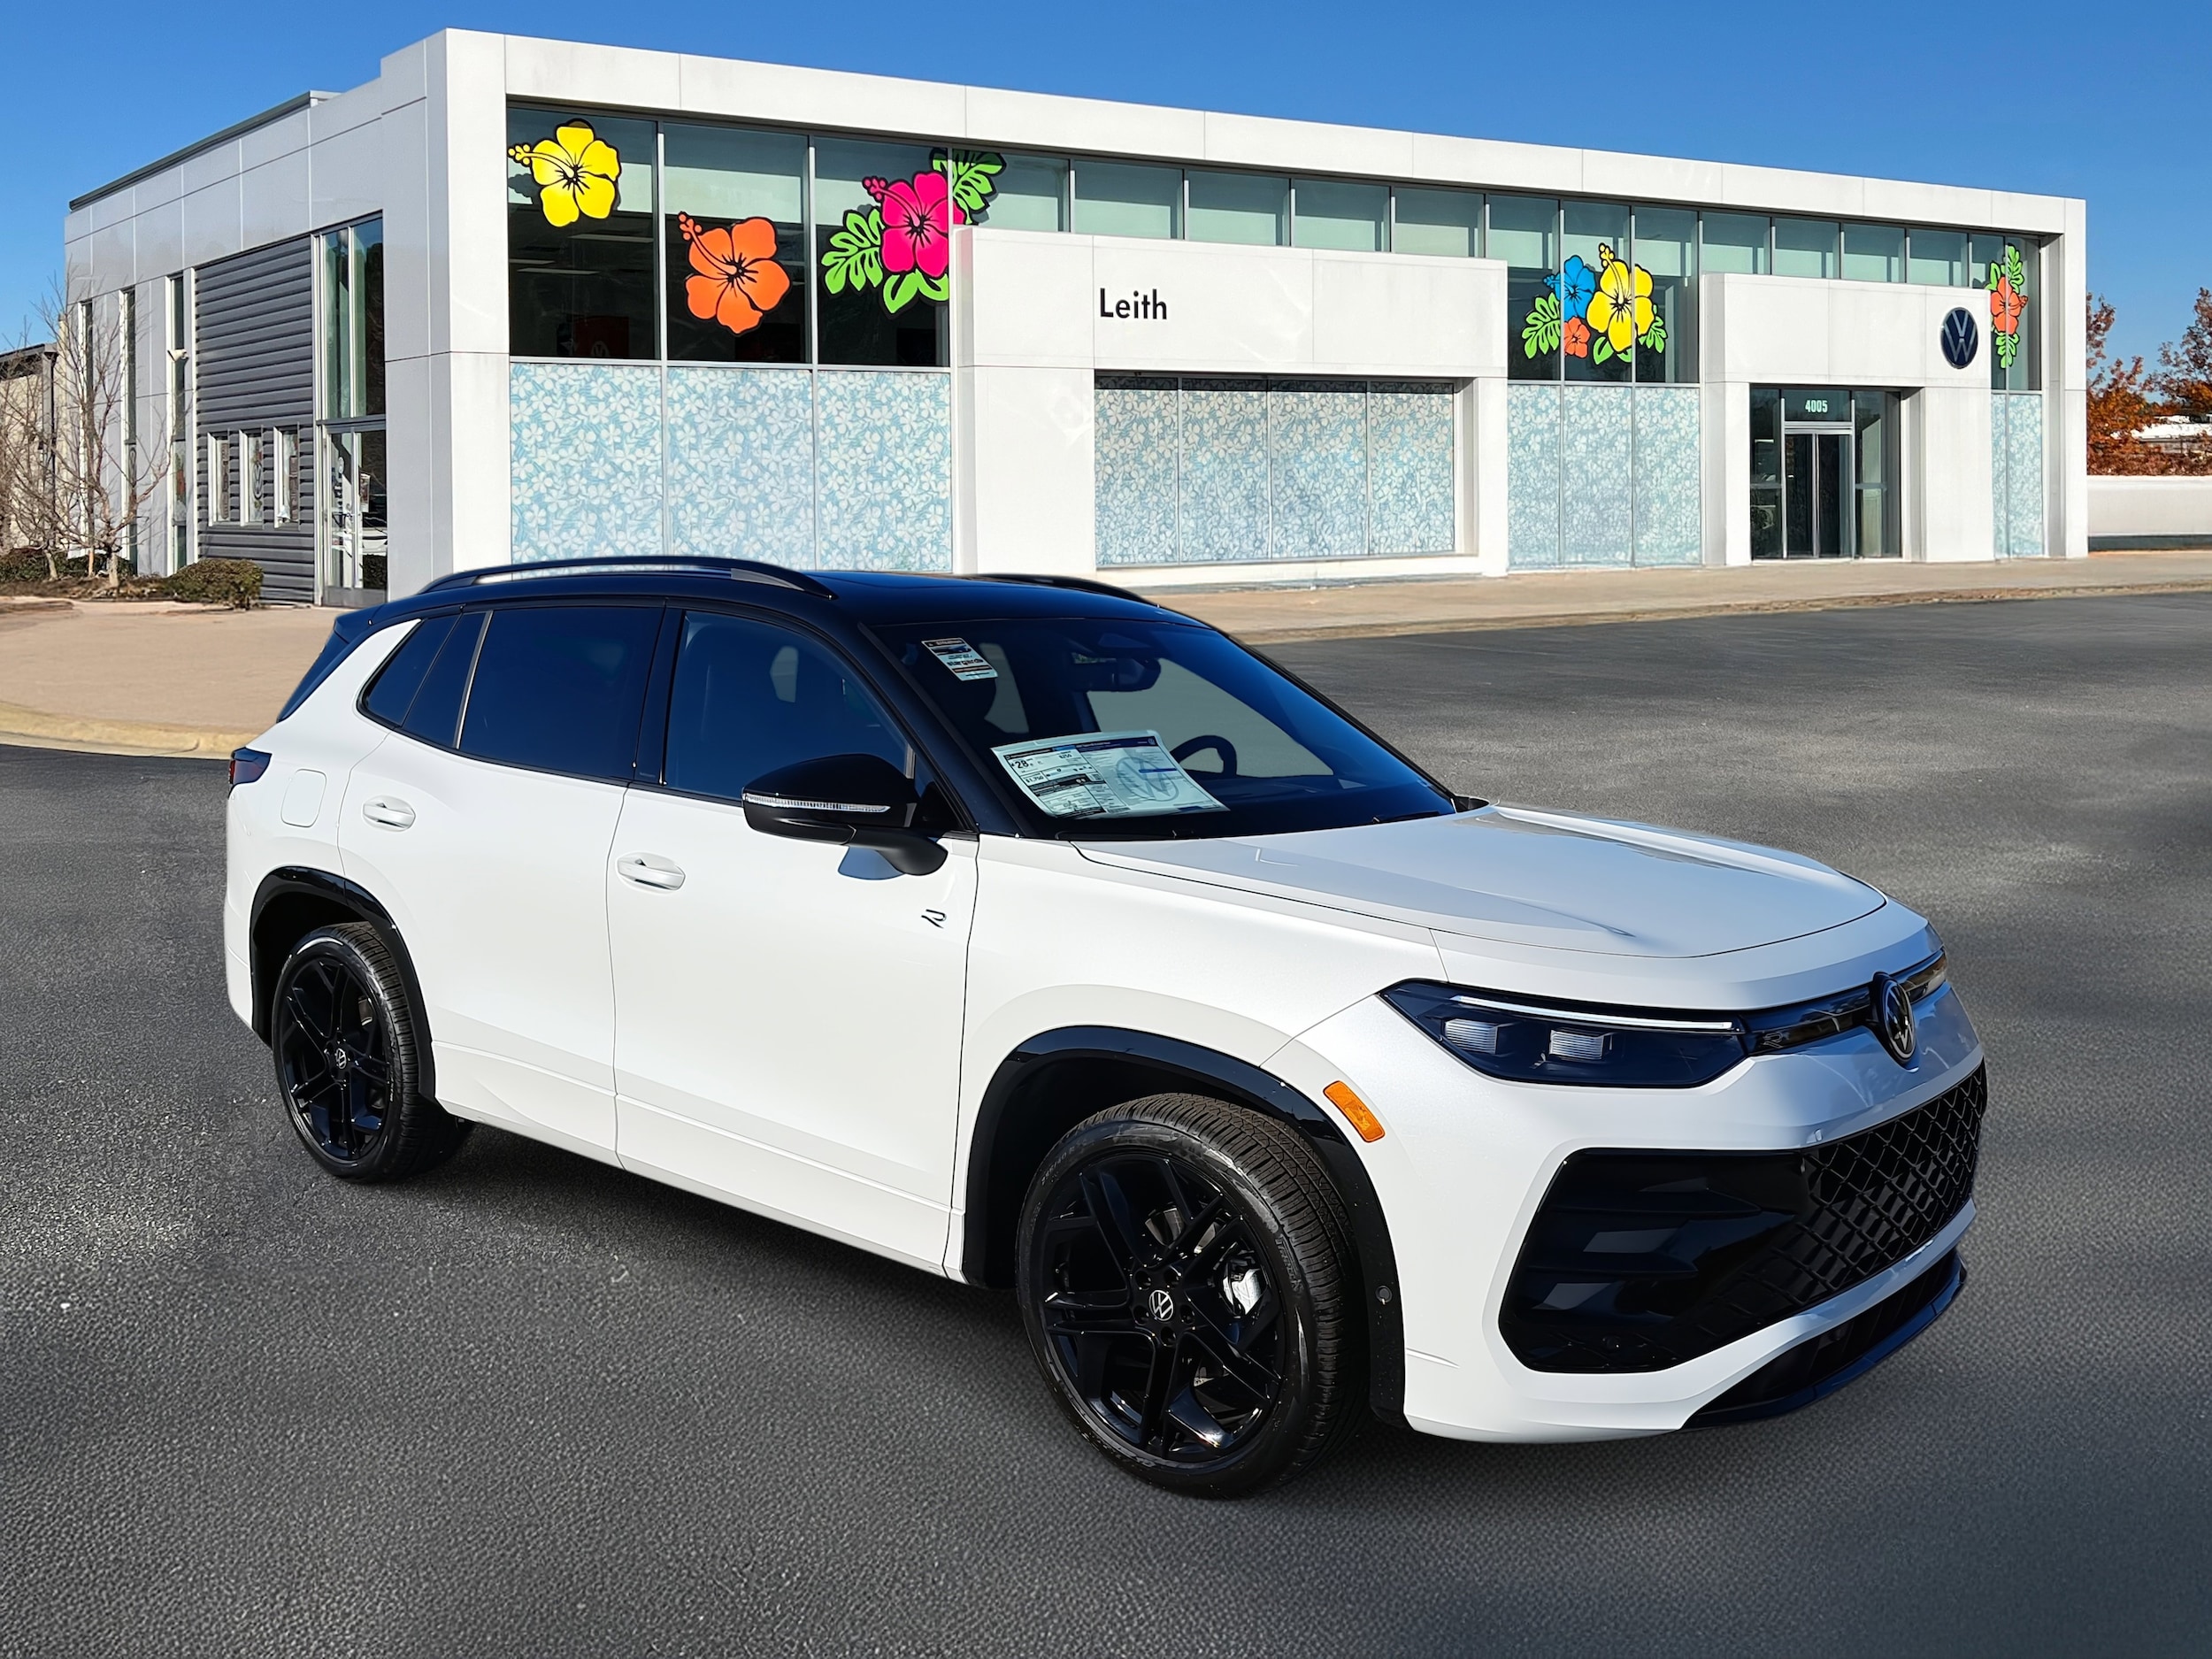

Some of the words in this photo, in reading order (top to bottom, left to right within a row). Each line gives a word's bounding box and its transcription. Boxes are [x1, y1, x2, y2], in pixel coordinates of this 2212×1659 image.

[1100, 288, 1167, 319] Leith
[1805, 399, 1828, 413] 4005
[1014, 759, 1029, 769] 28
